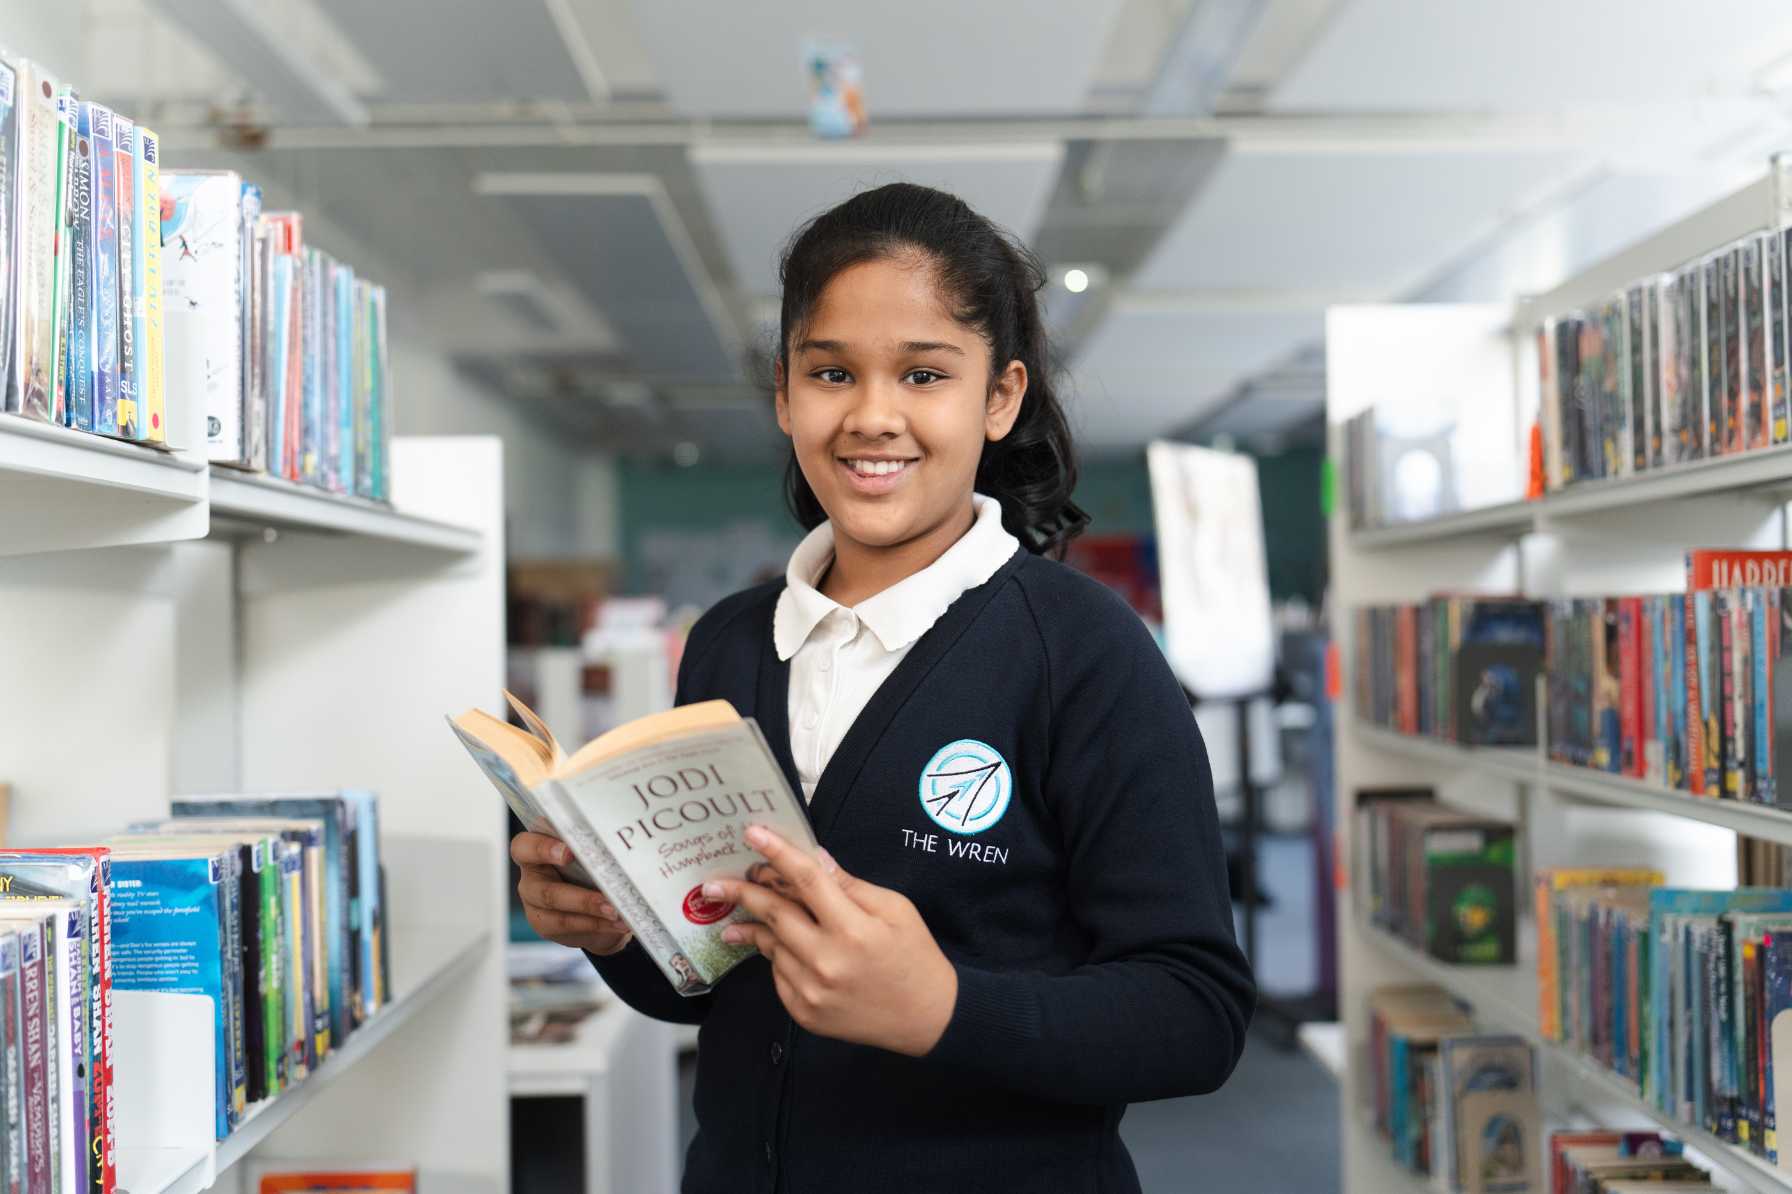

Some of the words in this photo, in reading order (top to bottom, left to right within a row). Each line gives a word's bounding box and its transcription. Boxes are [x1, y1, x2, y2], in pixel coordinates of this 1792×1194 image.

[79, 159, 91, 221] SIMON
[631, 763, 725, 811] JODI
[615, 788, 777, 851] PICOULT
[658, 830, 714, 858] Songs
[718, 824, 737, 841] of
[658, 840, 738, 880] Humpback
[901, 828, 939, 853] THE
[947, 838, 1009, 865] WREN
[28, 1017, 42, 1068] SHAN
[73, 1004, 82, 1055] BABY
